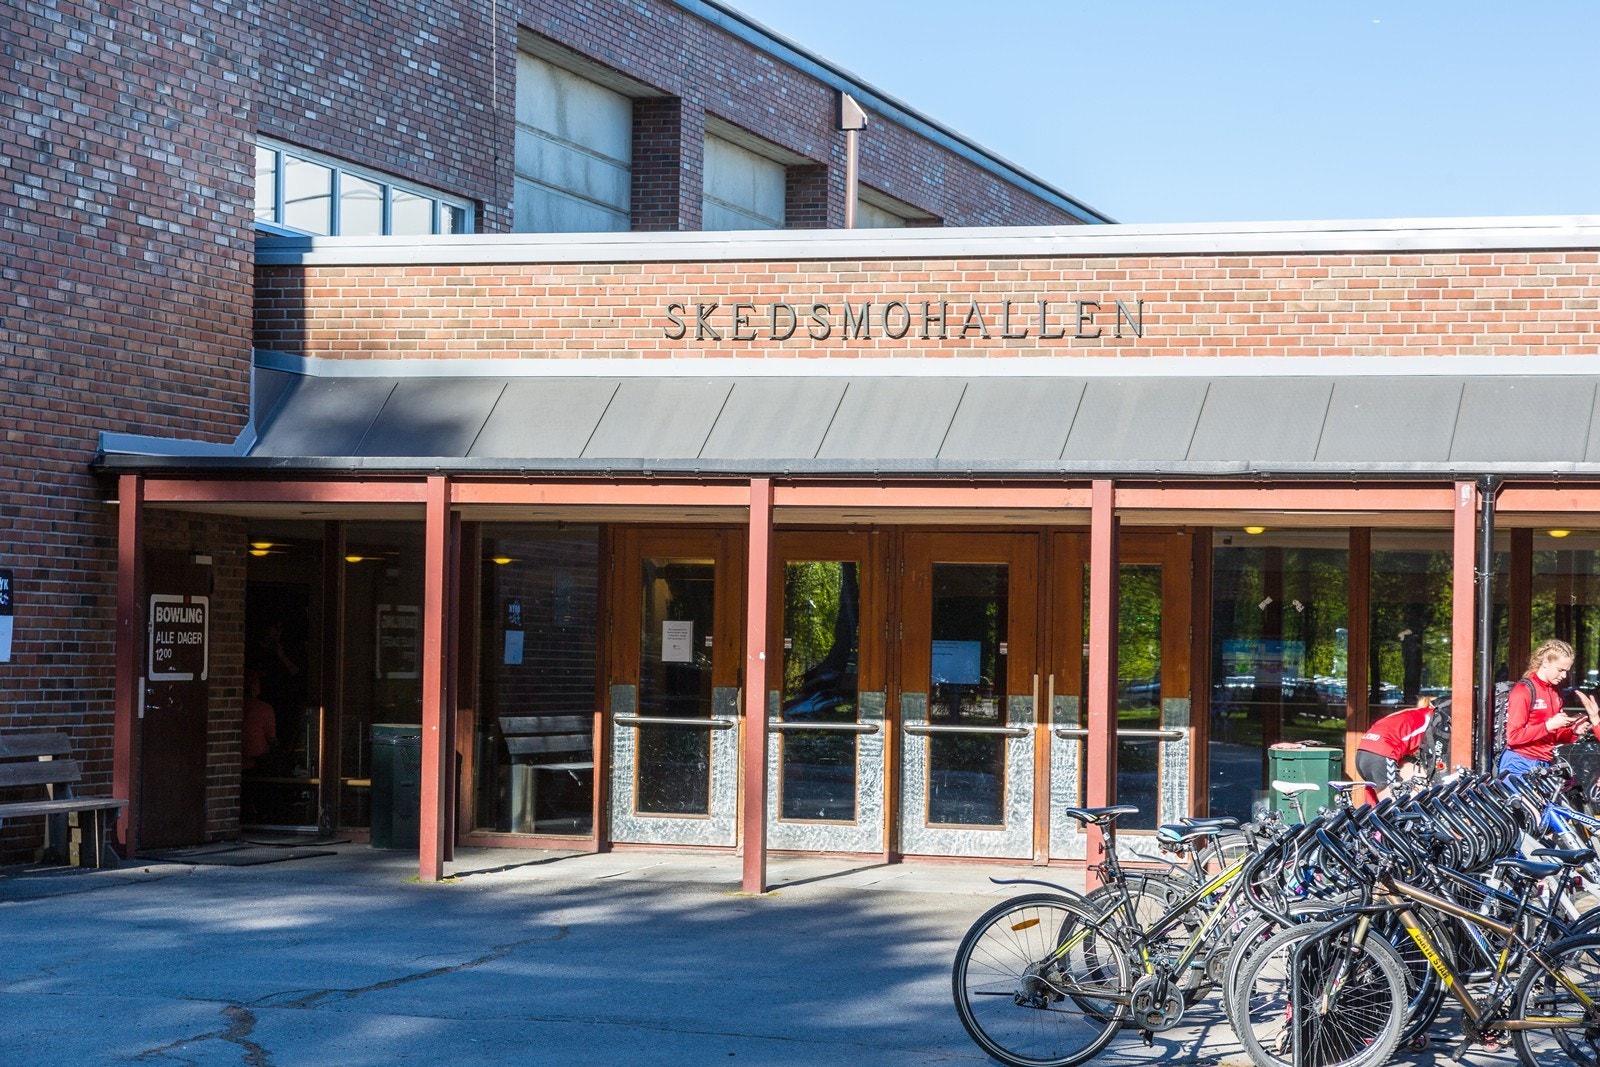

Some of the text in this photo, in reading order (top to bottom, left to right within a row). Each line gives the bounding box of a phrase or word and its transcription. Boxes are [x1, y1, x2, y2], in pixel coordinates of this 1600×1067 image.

[663, 299, 1144, 341] SKEDSMOHALLEN
[155, 606, 203, 623] BOWLING
[155, 631, 203, 645] ALLE DAGER
[1415, 932, 1451, 979] EARTH STAR
